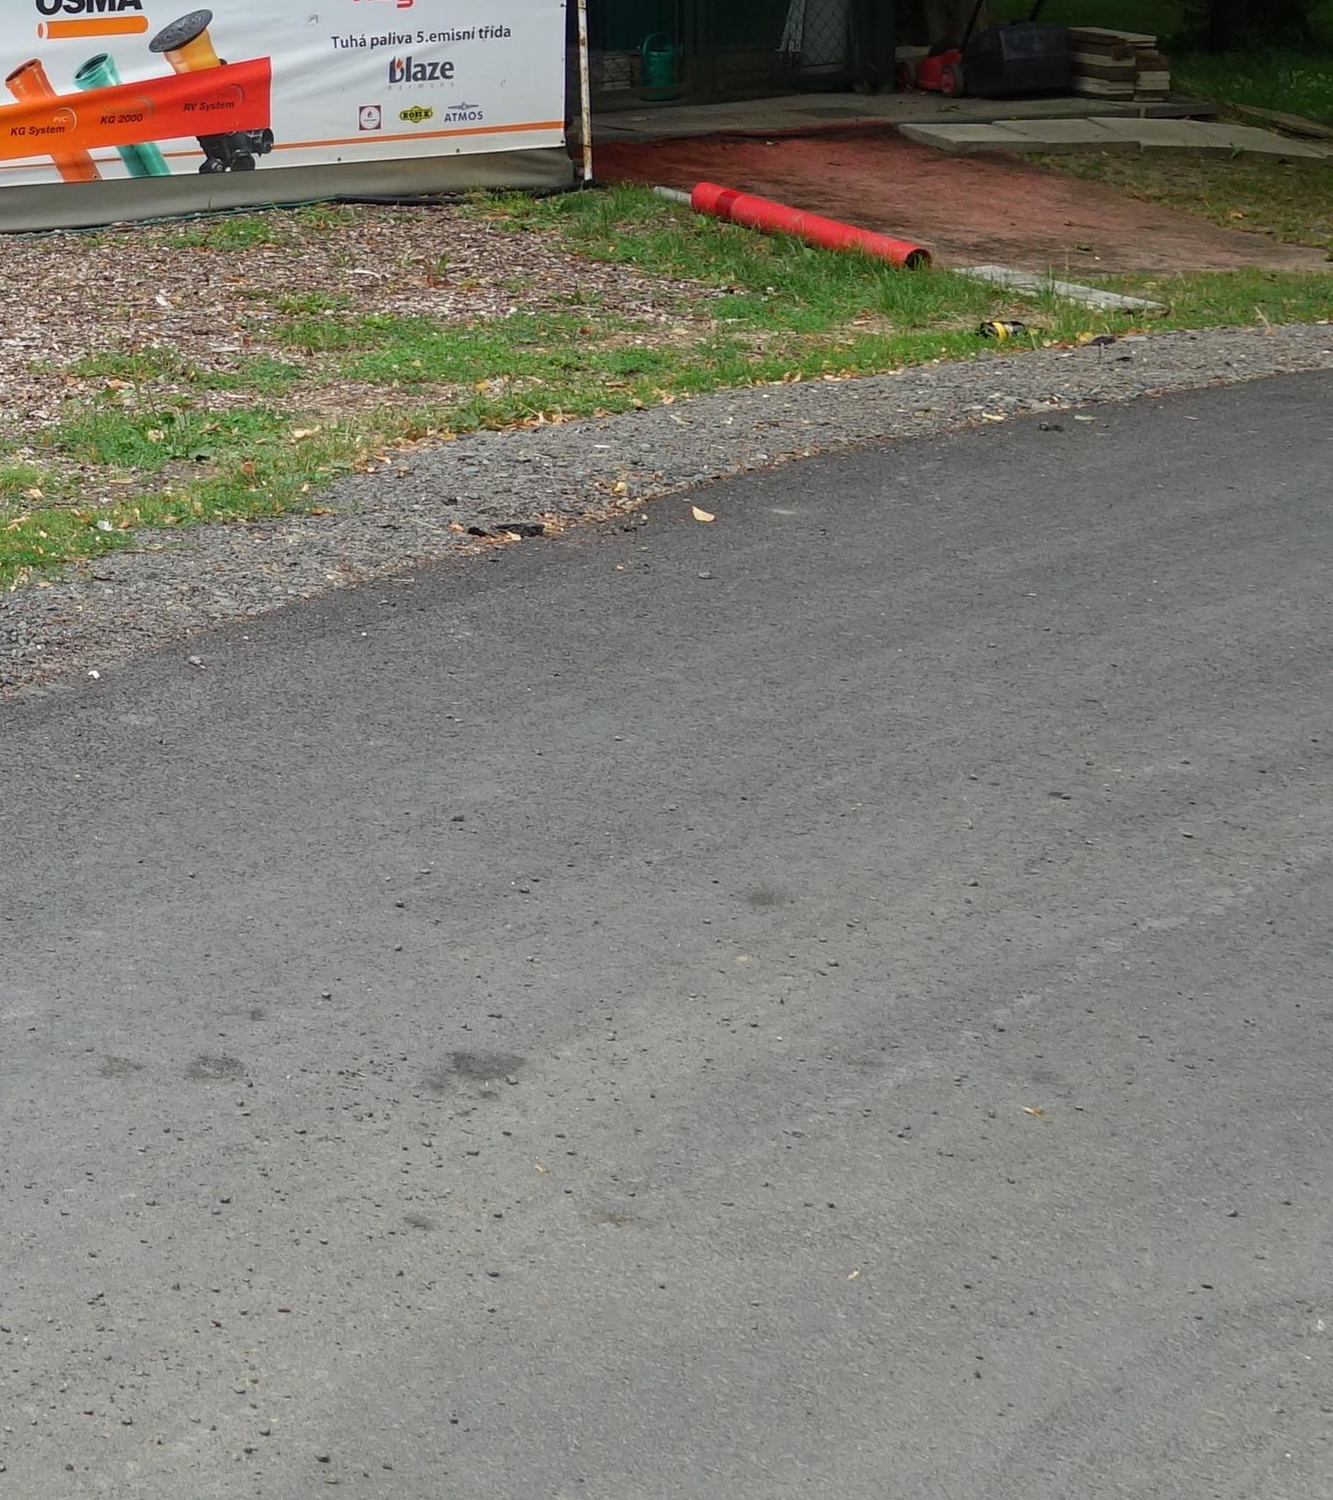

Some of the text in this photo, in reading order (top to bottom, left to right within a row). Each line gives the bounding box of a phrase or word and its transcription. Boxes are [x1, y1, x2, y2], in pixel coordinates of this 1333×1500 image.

[331, 25, 511, 50] Tuhá paliva 5.emisní třída
[199, 100, 235, 112] System
[100, 114, 143, 125] KG 2000
[444, 110, 484, 122] ATMOS
[10, 126, 65, 136] KG System
